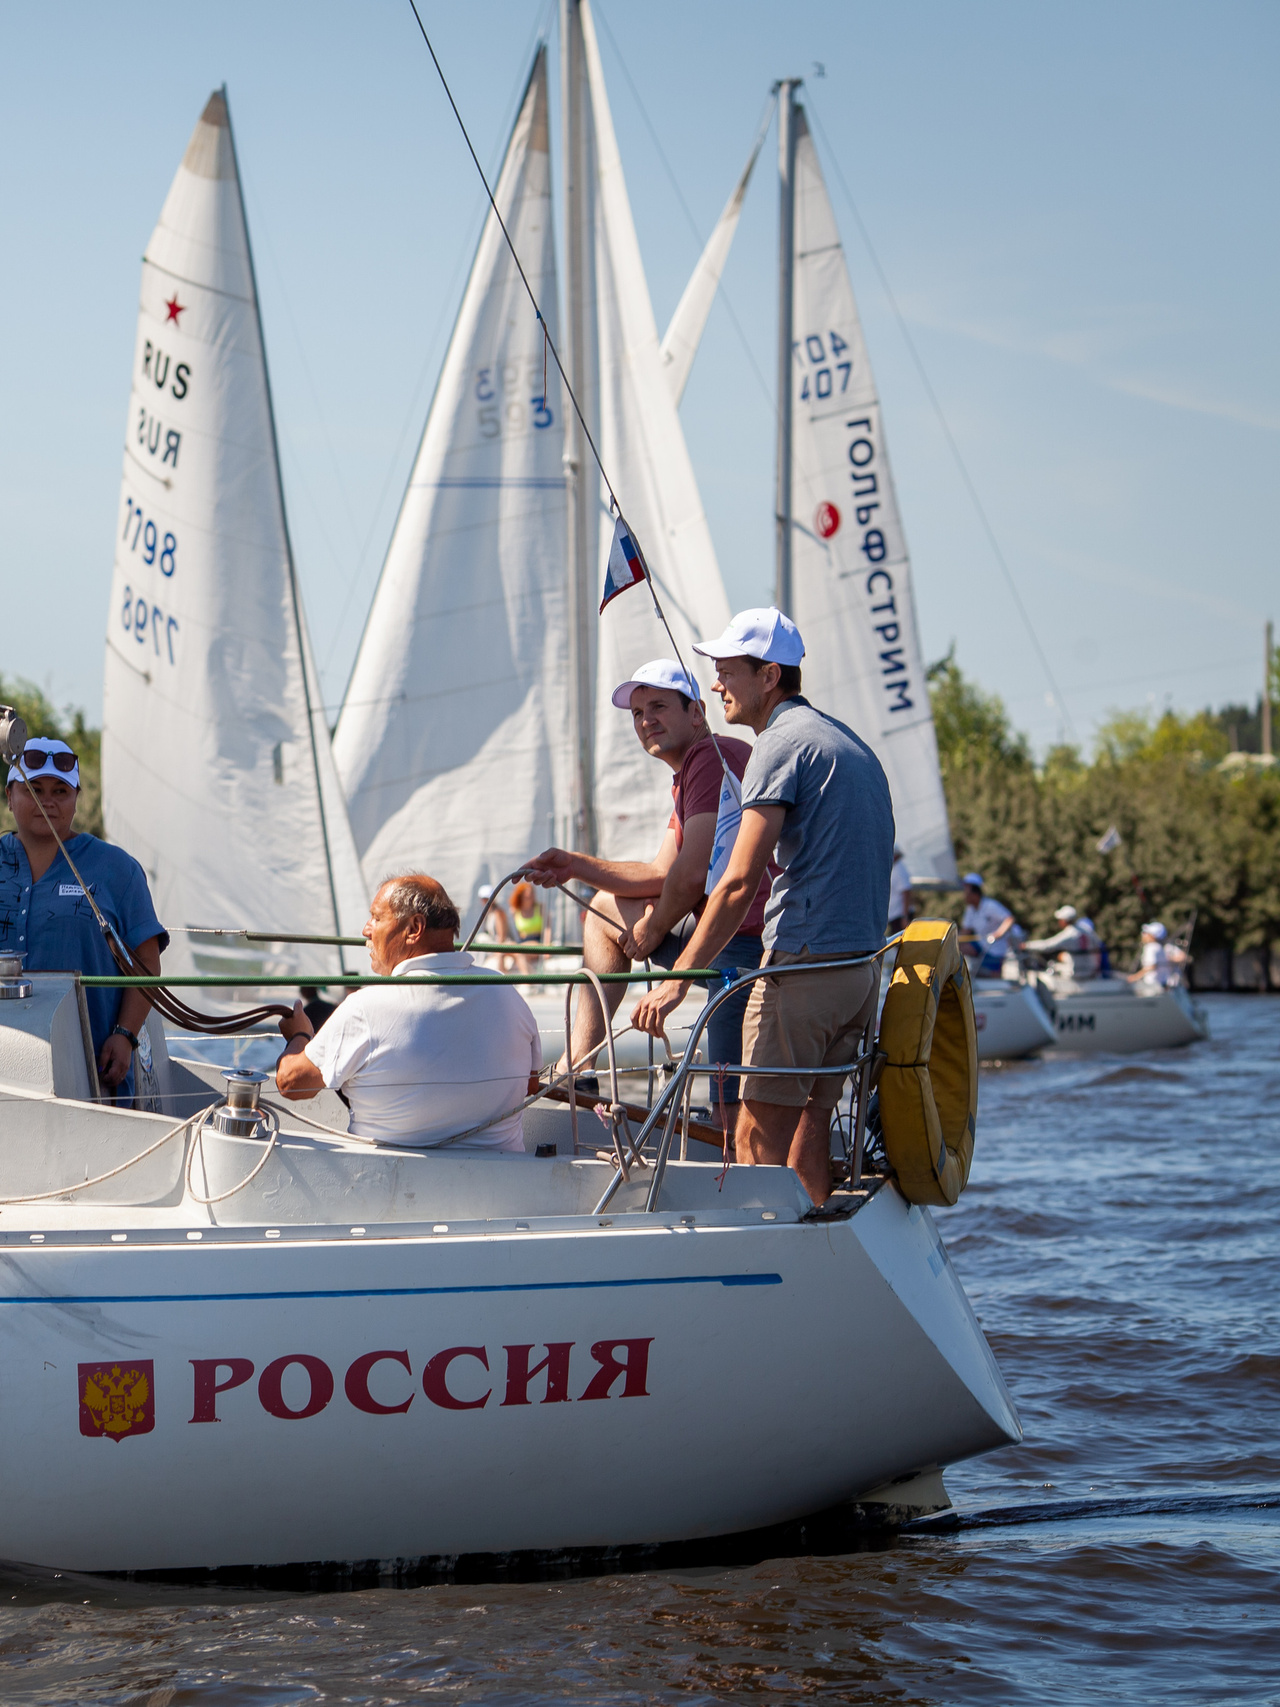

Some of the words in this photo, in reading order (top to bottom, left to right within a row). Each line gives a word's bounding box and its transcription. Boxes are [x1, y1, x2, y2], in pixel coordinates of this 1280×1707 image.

[142, 340, 192, 400] RUS
[122, 497, 177, 577] 7798
[846, 416, 913, 713] ГОЛЬФСТРИМ
[187, 1337, 655, 1424] РОССИЯ
